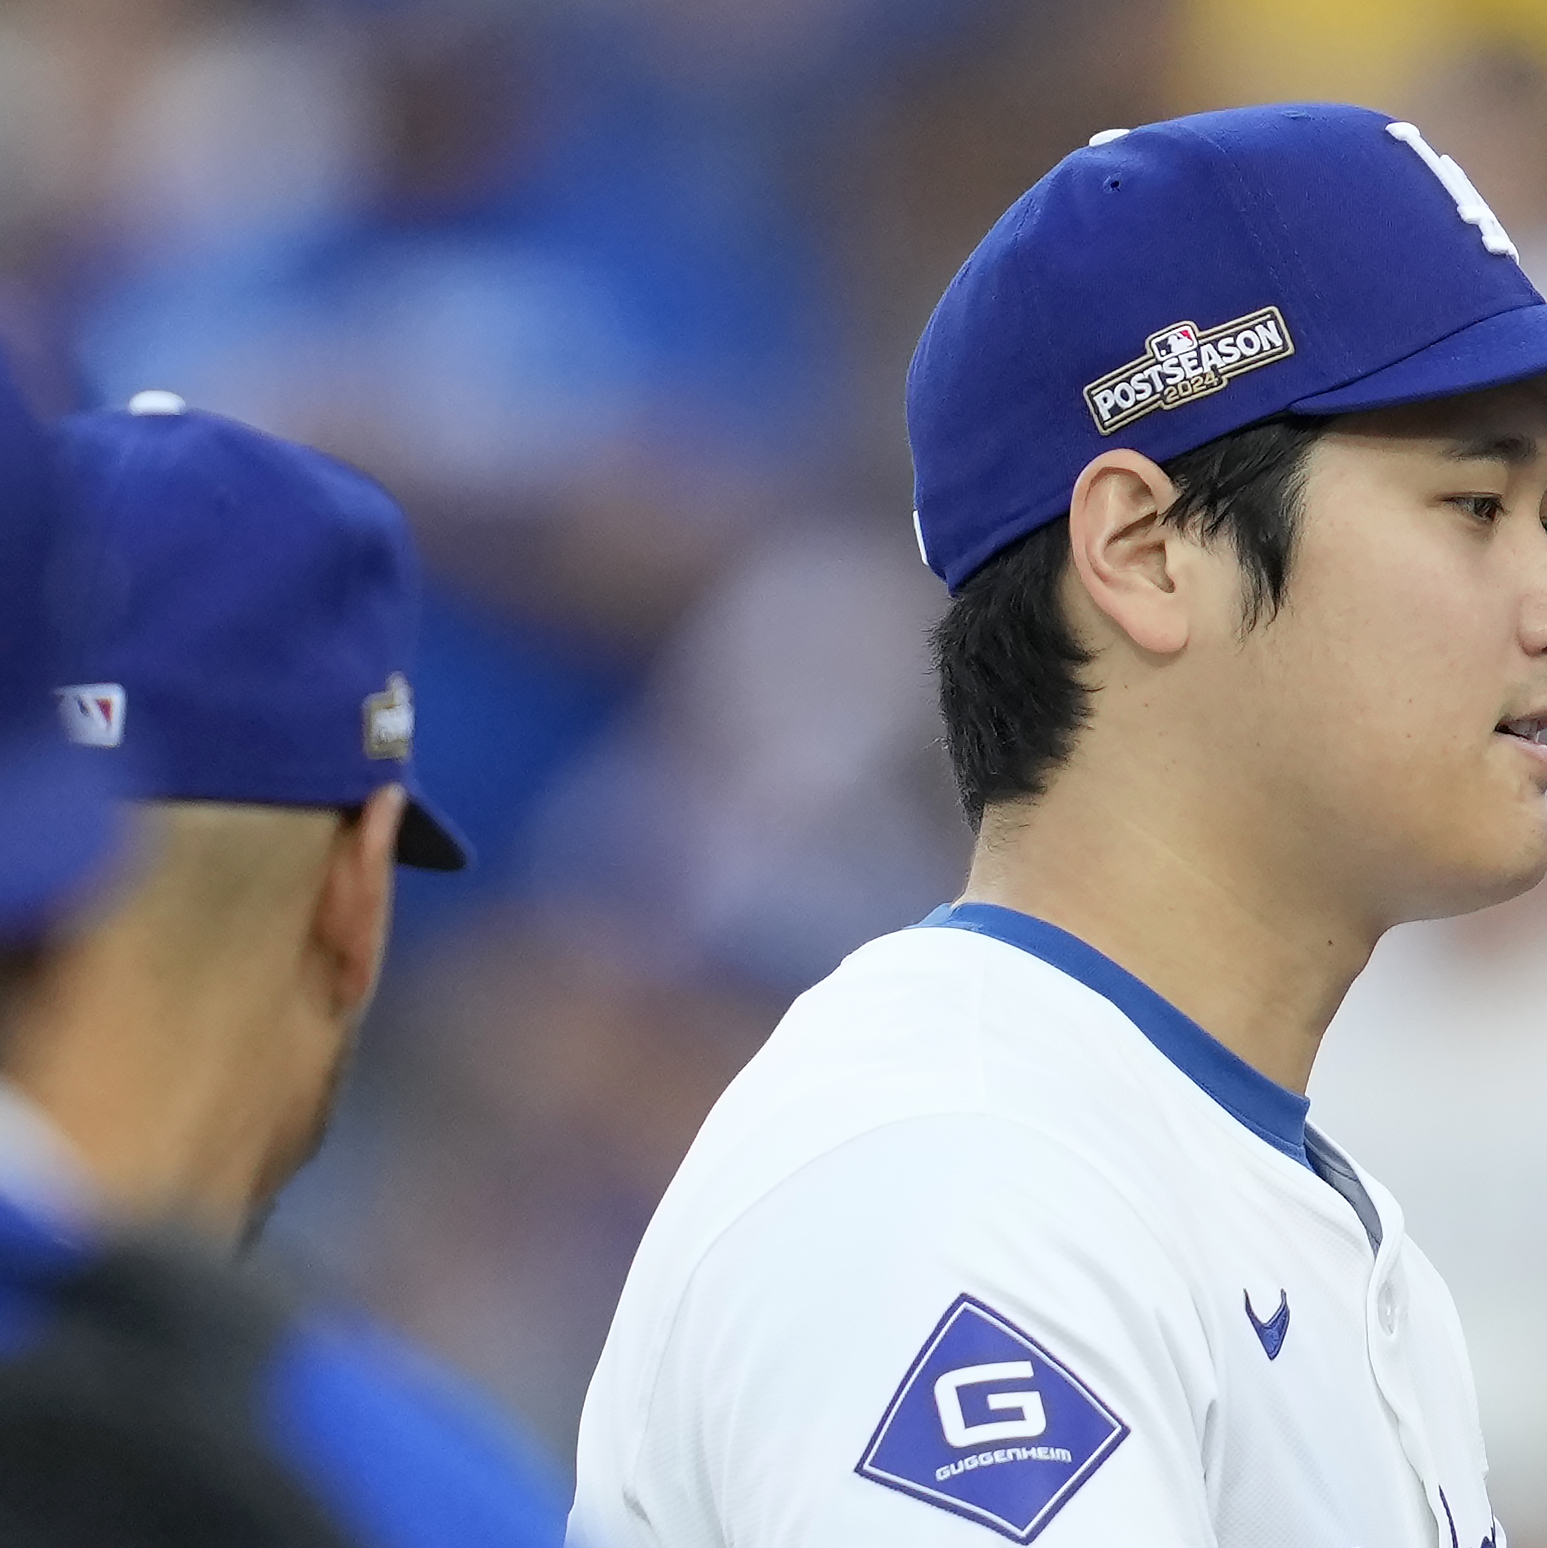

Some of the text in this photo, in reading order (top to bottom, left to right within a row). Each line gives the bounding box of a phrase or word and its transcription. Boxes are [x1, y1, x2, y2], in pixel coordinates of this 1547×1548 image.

[1092, 320, 1284, 421] POSTSEASON
[1163, 372, 1219, 402] 2024
[934, 1360, 1047, 1449] G
[935, 1446, 1073, 1482] GUGGENHEIM
